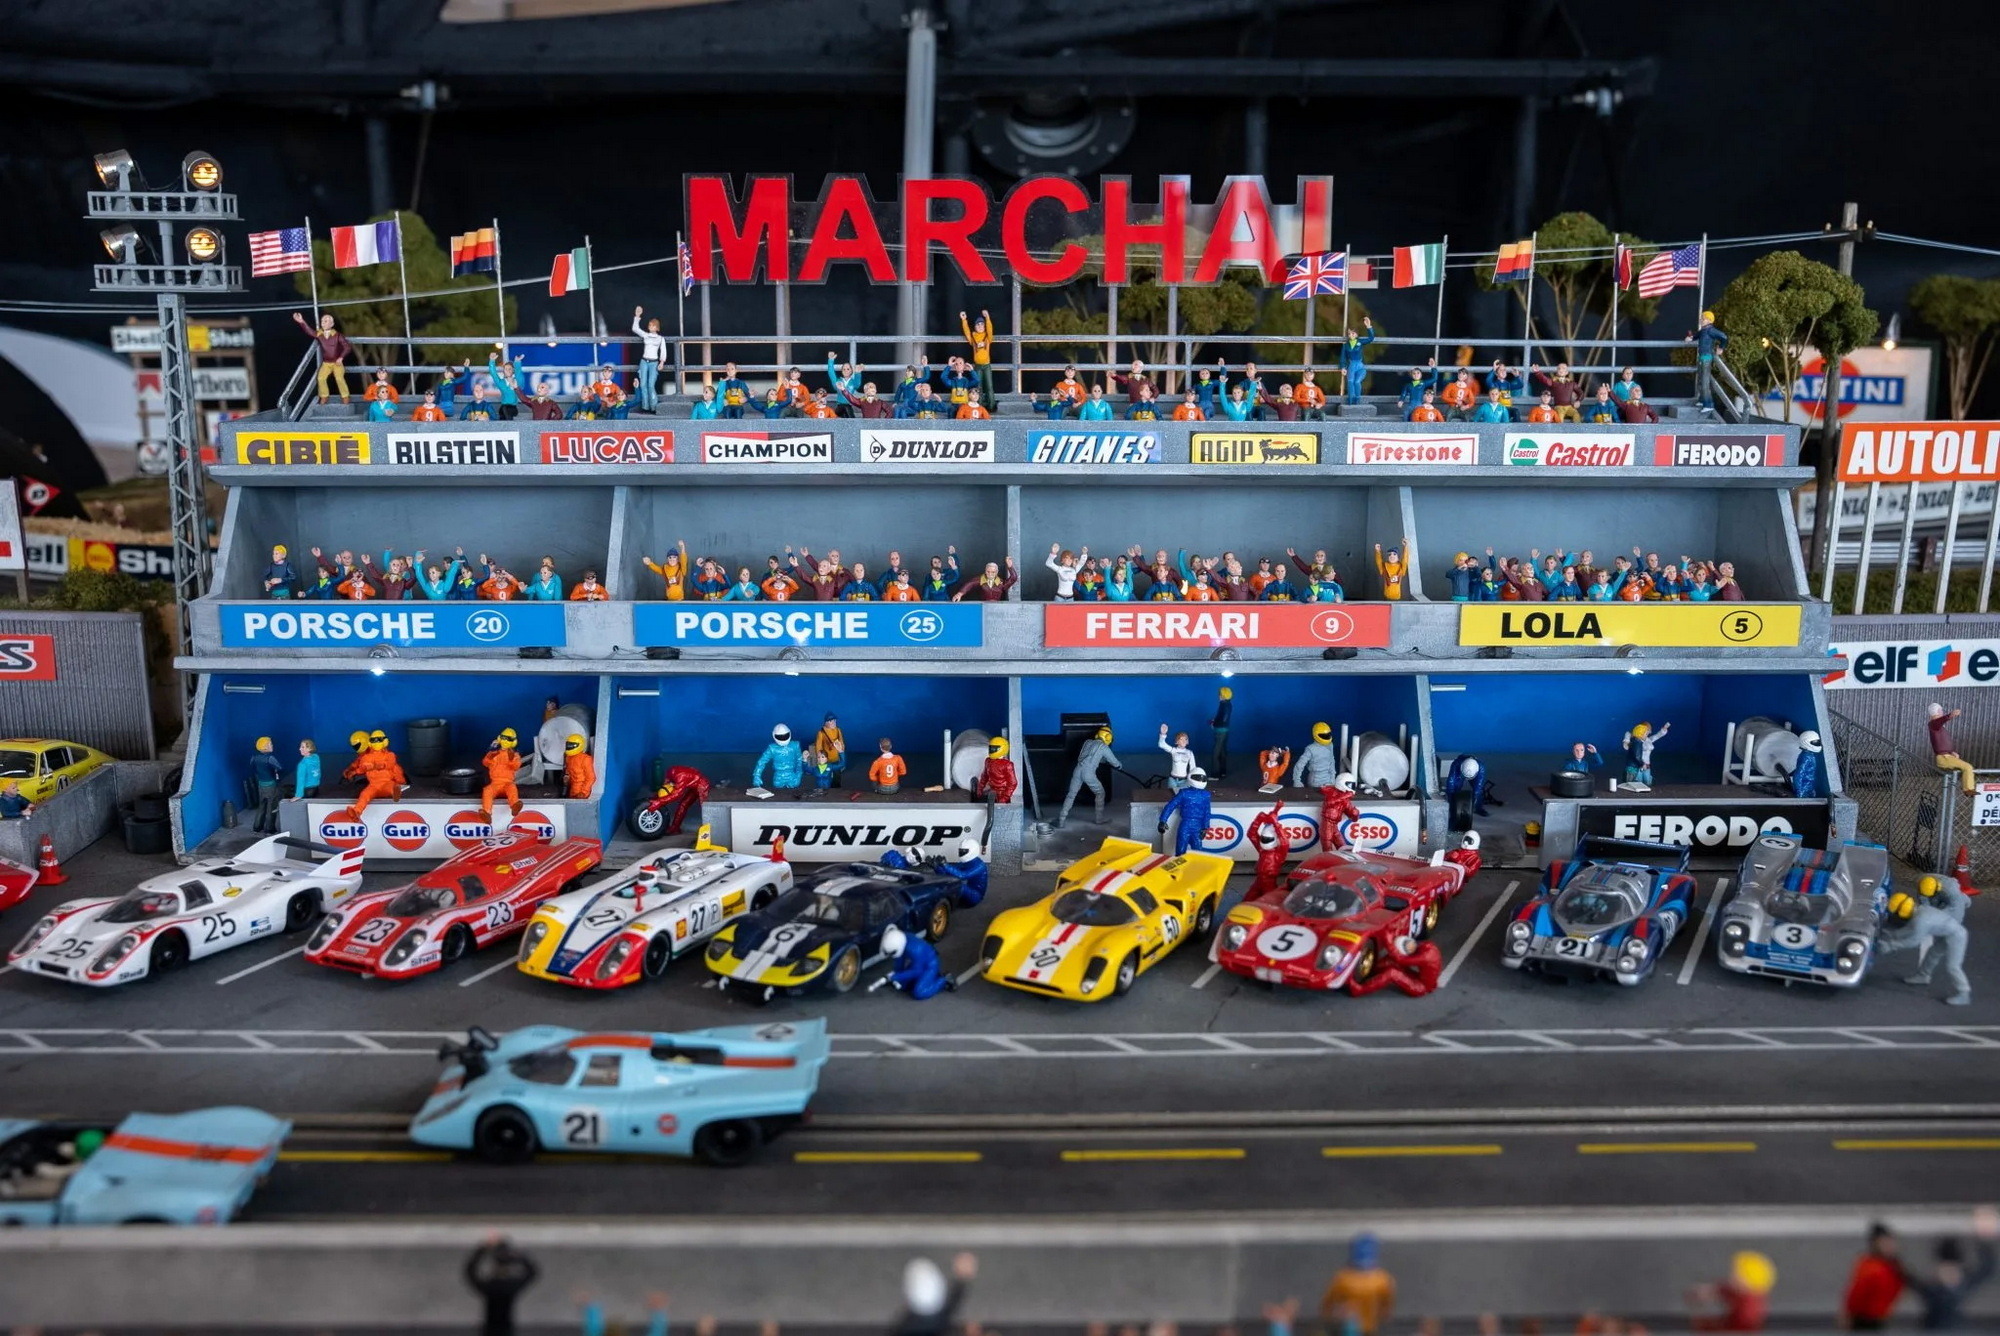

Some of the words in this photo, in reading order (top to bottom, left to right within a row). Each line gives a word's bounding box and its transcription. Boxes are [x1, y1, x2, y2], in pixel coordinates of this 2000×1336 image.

[426, 411, 433, 421] 9
[396, 440, 514, 464] BILSTEIN
[549, 436, 664, 462] LUCAS
[709, 443, 827, 458] CHAMPION
[889, 441, 988, 458] DUNLOP
[1032, 435, 1155, 463] GITANES
[1200, 440, 1254, 462] AGIP
[1362, 442, 1462, 463] Firestone
[1513, 449, 1539, 459] Castrol
[1545, 442, 1630, 466] Castrol
[1678, 444, 1761, 466] FERODO
[244, 612, 435, 639] PORSCHE
[474, 618, 502, 633] 20
[676, 612, 868, 639] PORSCHE
[907, 617, 935, 633] 25
[1086, 612, 1259, 639] FERRARI
[1325, 618, 1340, 634] 9
[1501, 612, 1602, 639] LOLA
[1735, 618, 1749, 634] 5
[1854, 647, 1918, 684] elf
[886, 764, 894, 778] 9
[322, 825, 365, 837] Gulf
[385, 825, 427, 837] Gulf
[447, 825, 489, 837] Gulf
[1614, 815, 1793, 847] FERODO
[513, 857, 537, 868] Shell
[488, 901, 511, 927] 23
[591, 909, 622, 928] 27
[692, 905, 706, 935] 27
[203, 912, 236, 944] 25
[354, 919, 397, 943] 23
[1786, 927, 1803, 944] 3
[47, 938, 94, 959] 25
[1271, 931, 1304, 952] 5
[1559, 939, 1589, 957] 21
[1031, 948, 1061, 969] 50
[564, 1113, 600, 1145] 21
